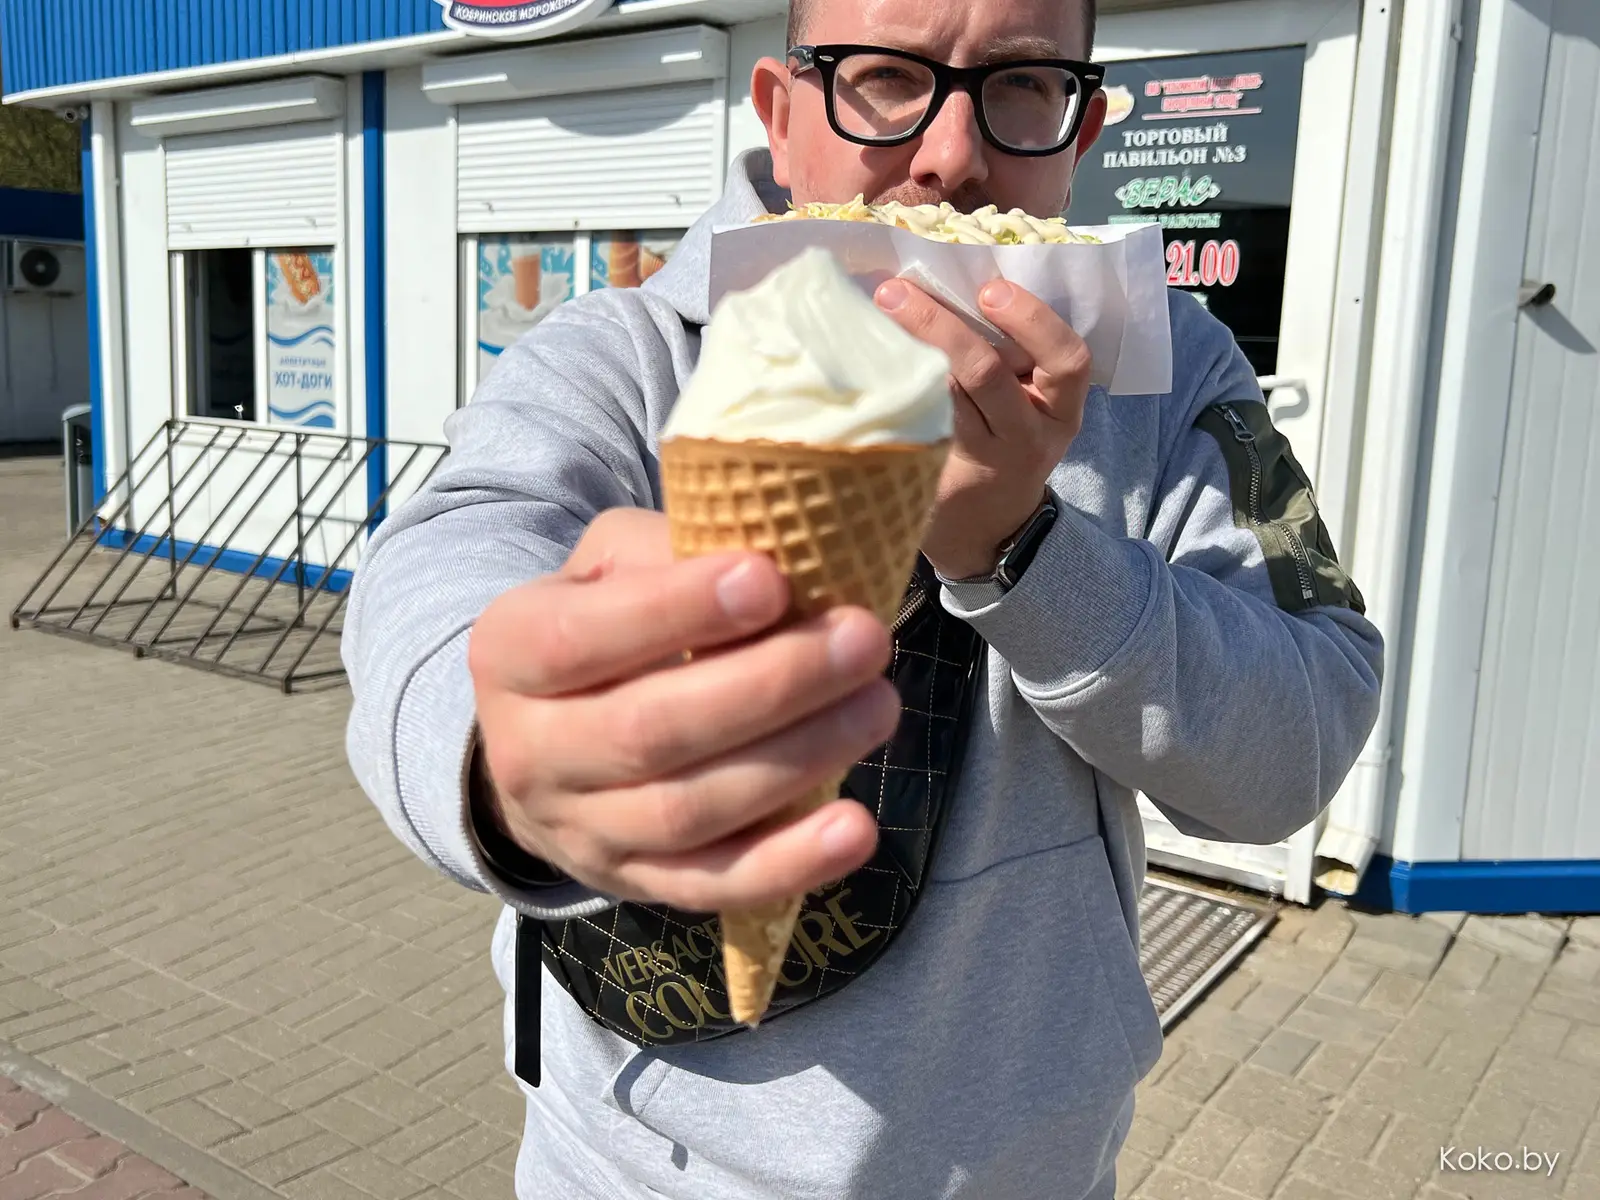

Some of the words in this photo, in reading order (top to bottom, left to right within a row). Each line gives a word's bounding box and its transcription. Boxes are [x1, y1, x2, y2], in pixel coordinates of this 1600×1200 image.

[455, 4, 517, 23] КОБРИНСКОЕ
[1122, 122, 1229, 147] ТОРГОВЫЙ
[1102, 147, 1208, 168] ПАВИЛЬОН
[1212, 145, 1247, 164] №3
[1165, 239, 1240, 287] 21.00
[275, 371, 333, 390] ХОТ-ДОГИ
[625, 888, 881, 1039] COUURE
